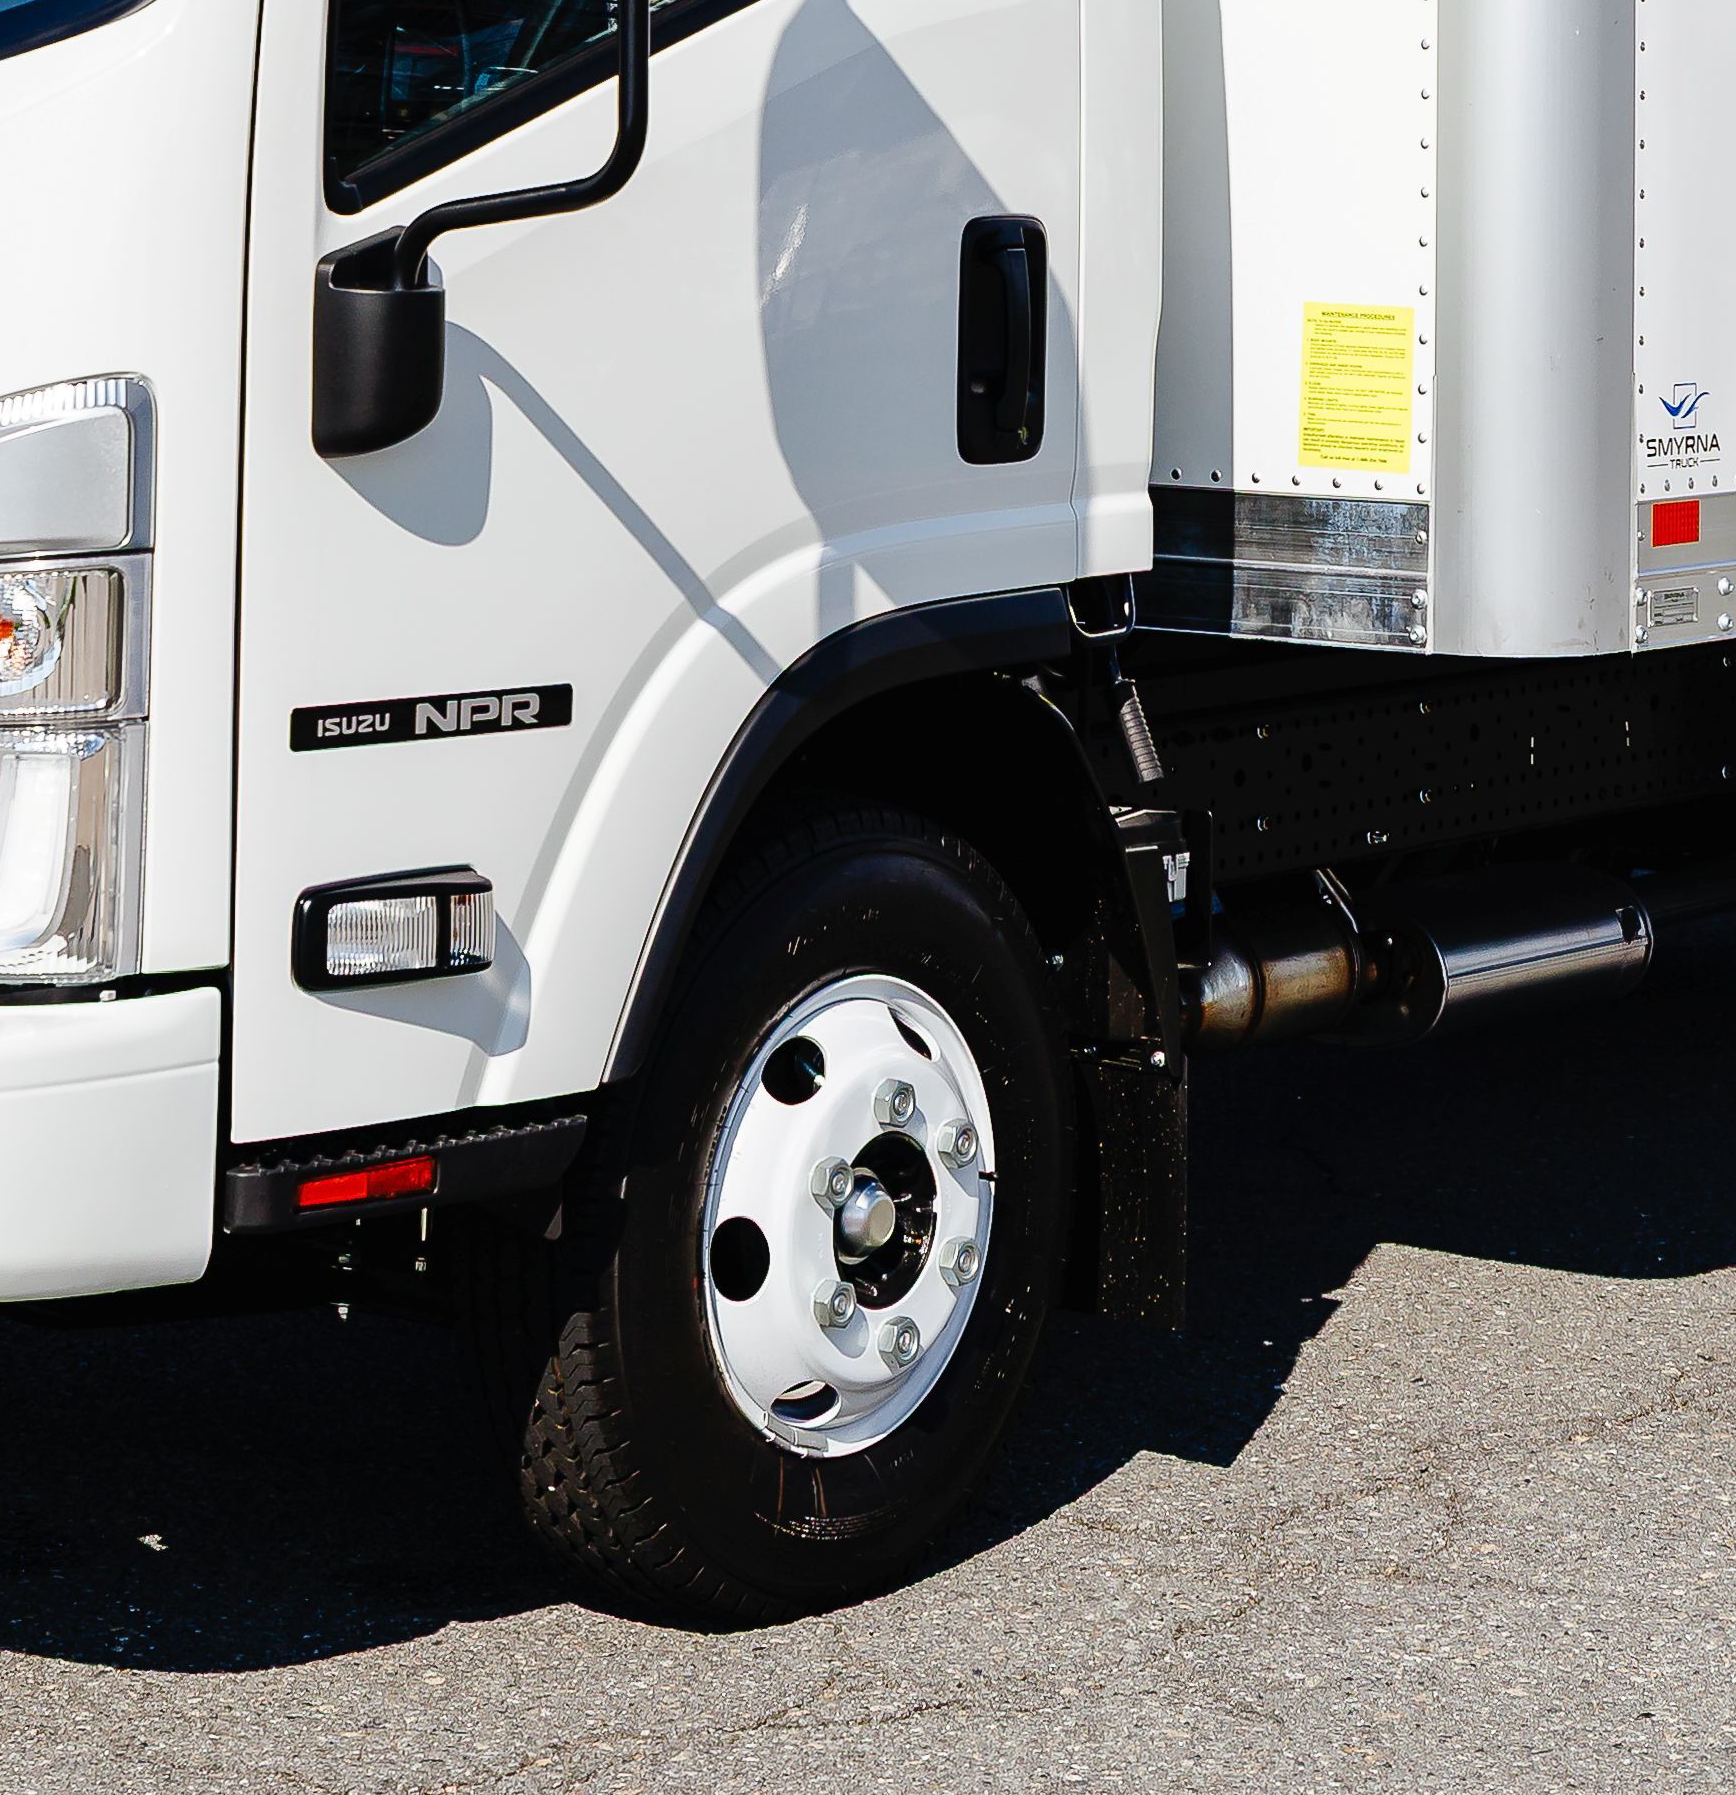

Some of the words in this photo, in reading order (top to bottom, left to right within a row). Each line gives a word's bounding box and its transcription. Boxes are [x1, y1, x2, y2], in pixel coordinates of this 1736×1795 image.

[1646, 433, 1721, 458] SMYRNA
[1669, 457, 1700, 470] TRUCK
[317, 713, 390, 737] ISUZU
[415, 693, 540, 734] NPR
